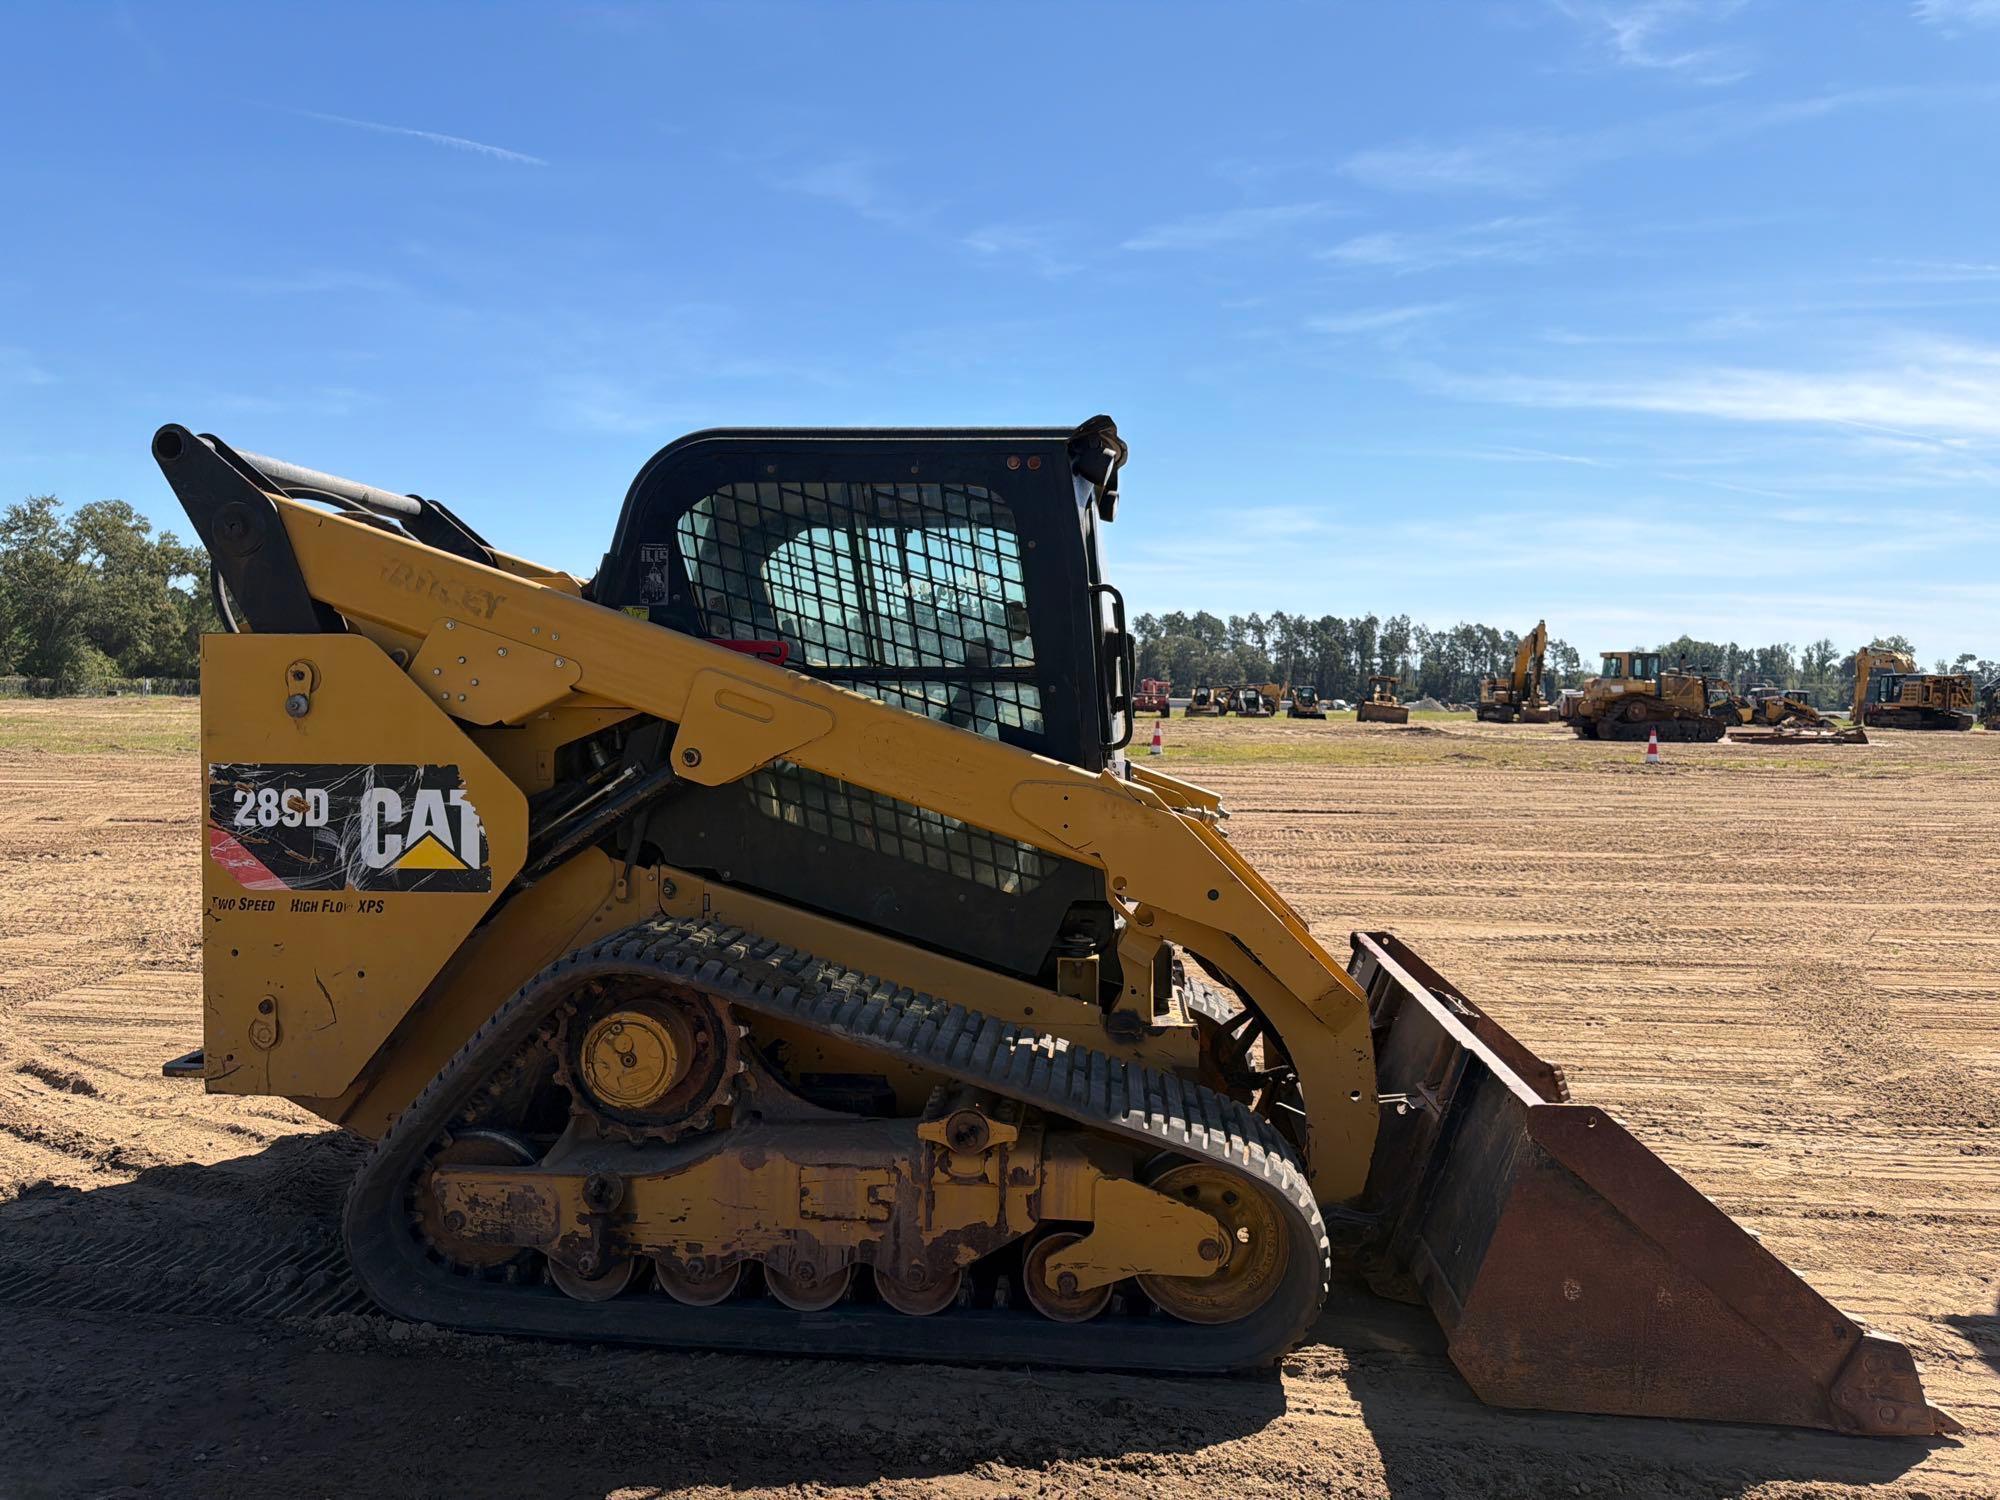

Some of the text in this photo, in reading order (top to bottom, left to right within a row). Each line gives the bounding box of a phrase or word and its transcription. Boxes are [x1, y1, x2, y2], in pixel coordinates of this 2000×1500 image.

[233, 787, 329, 828] 289D
[361, 787, 480, 870] CAT
[239, 897, 275, 911] SPEED
[290, 898, 352, 913] HIGH FLO
[358, 899, 385, 914] XPS
